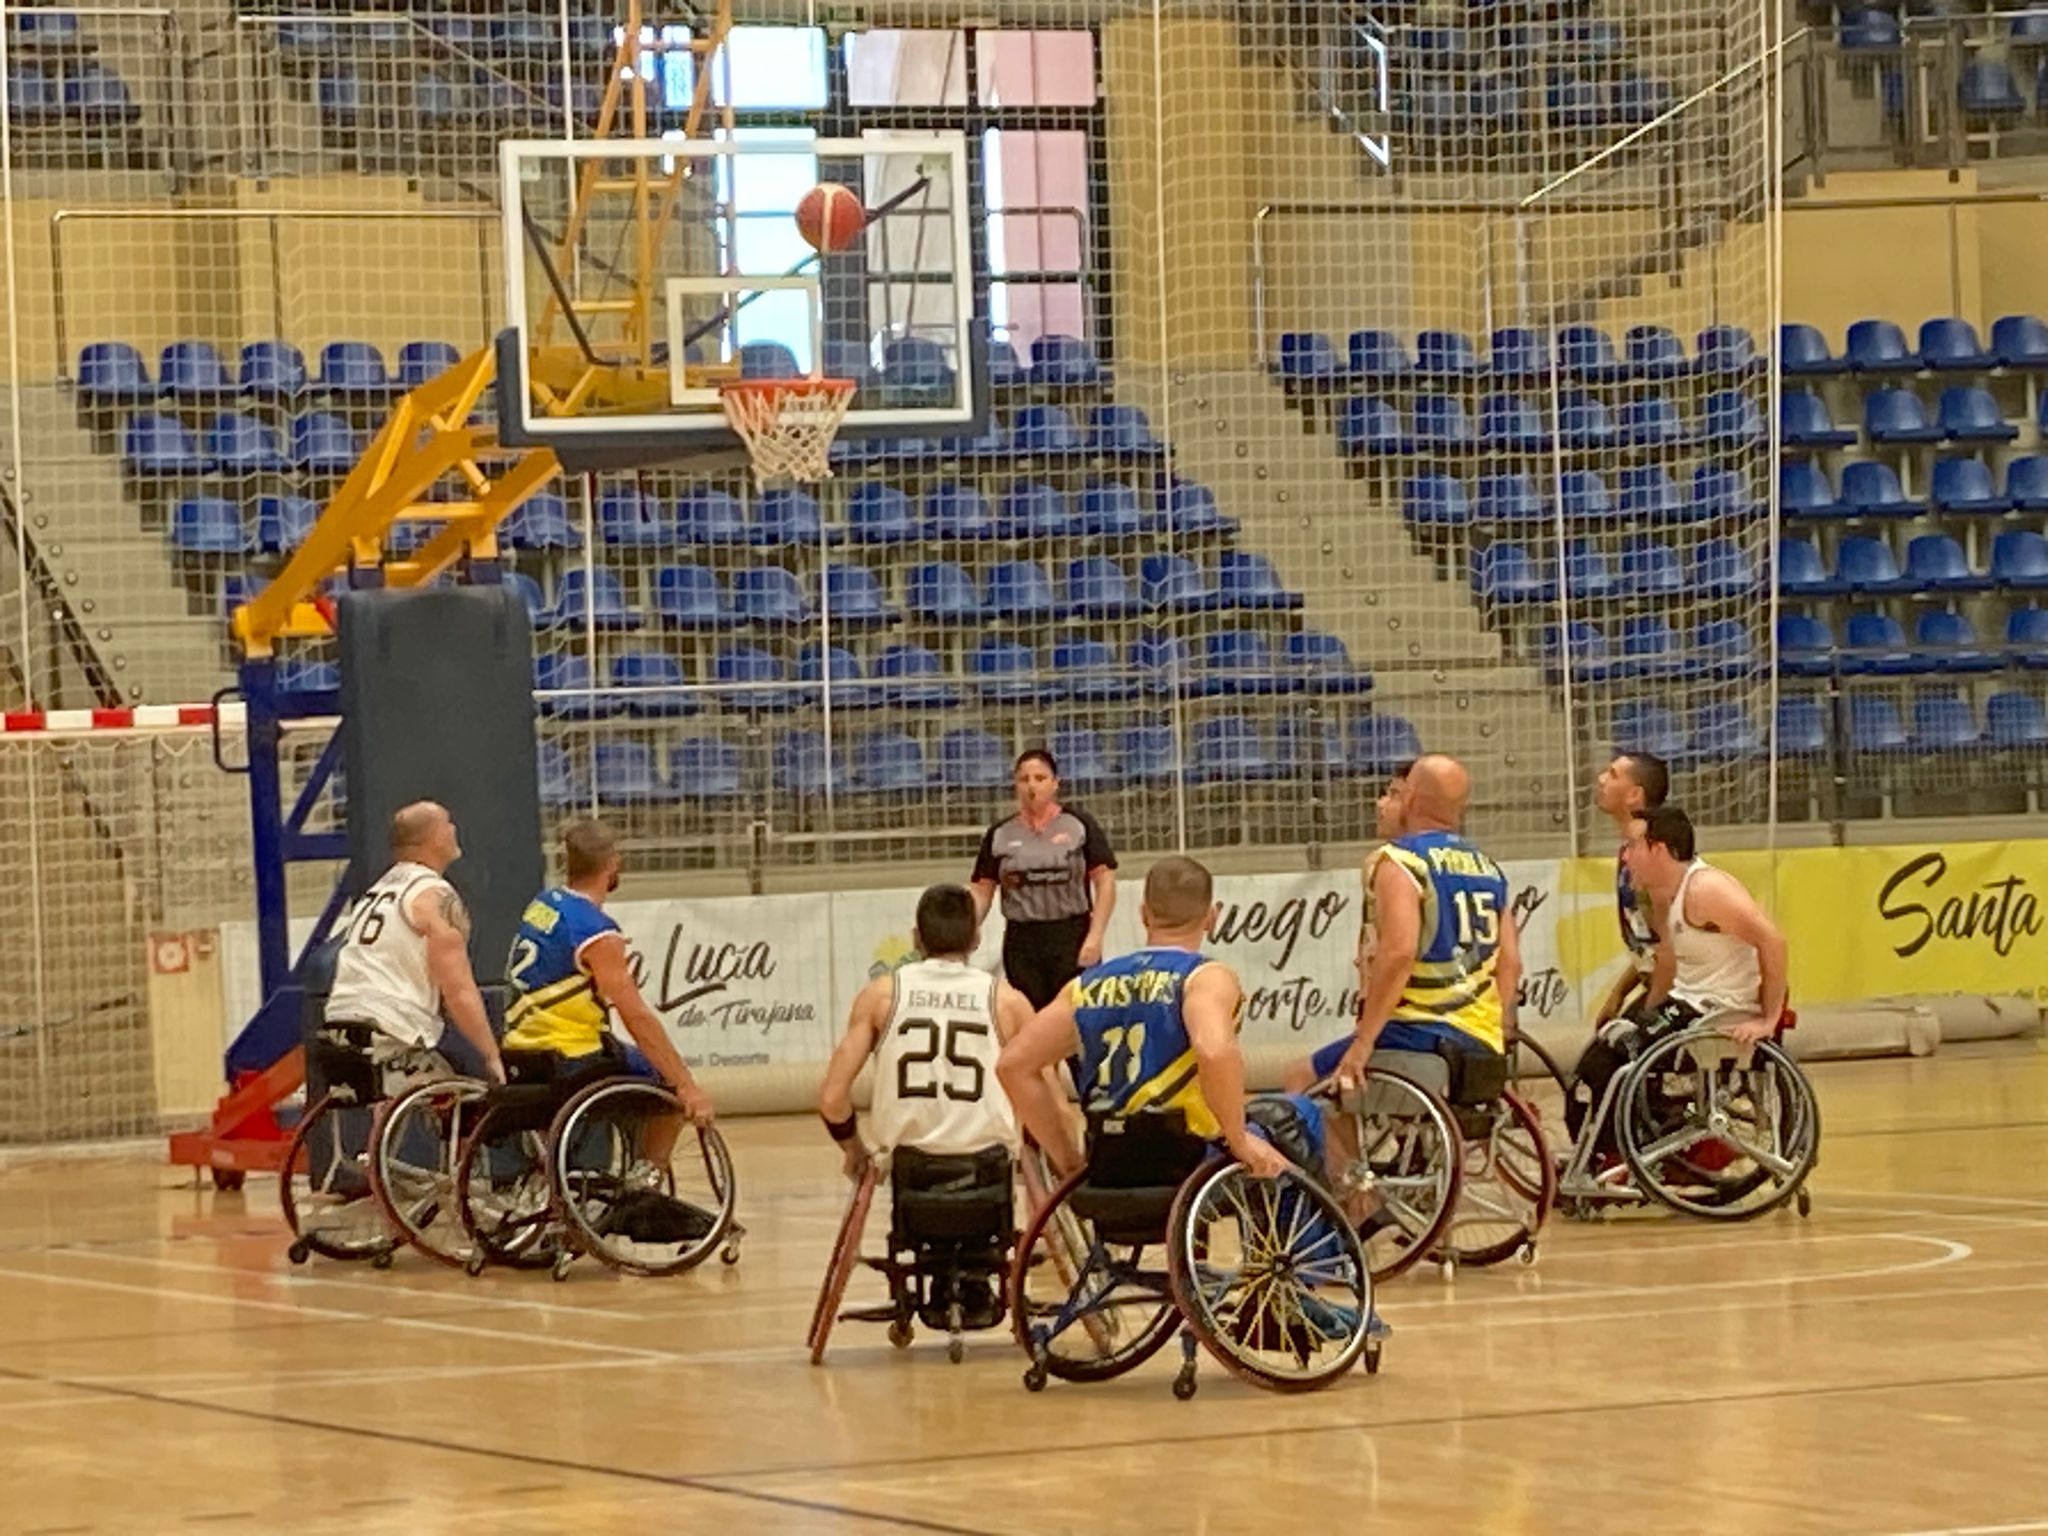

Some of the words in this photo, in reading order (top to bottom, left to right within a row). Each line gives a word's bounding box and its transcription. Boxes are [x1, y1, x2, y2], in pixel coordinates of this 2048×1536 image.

[1207, 891, 1350, 971] uego
[1454, 890, 1499, 945] 15
[1878, 852, 2044, 957] Santa
[656, 923, 777, 1013] Lucía
[711, 999, 816, 1035] Tirajana
[897, 1018, 989, 1102] 25
